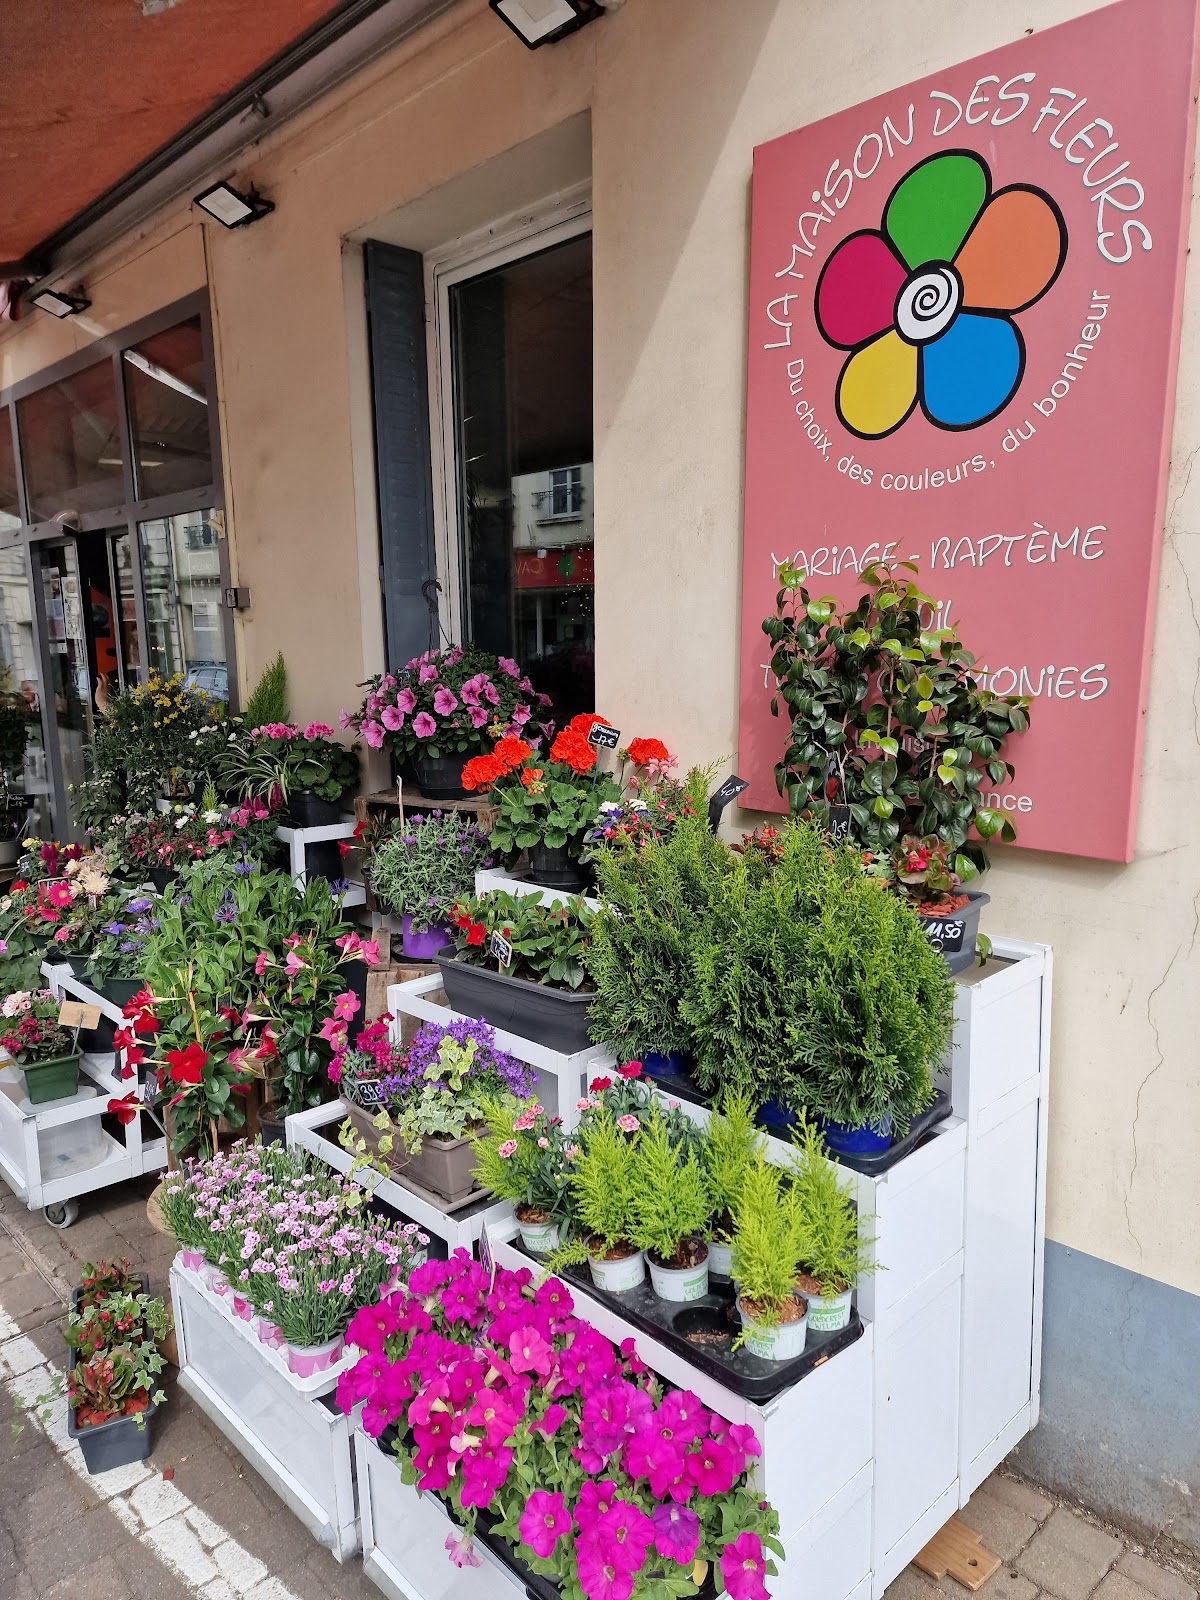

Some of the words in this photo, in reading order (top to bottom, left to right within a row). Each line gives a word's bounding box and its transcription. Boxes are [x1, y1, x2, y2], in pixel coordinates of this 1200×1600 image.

[764, 294, 799, 349] LA
[930, 72, 1036, 137] DES
[1032, 88, 1153, 263] FLEURS
[795, 400, 832, 462] choix,
[837, 454, 874, 485] des
[880, 454, 996, 491] couleurs,
[1001, 419, 1037, 453] du
[1033, 290, 1111, 418] bonheur
[931, 522, 1107, 569] BAPTÈME
